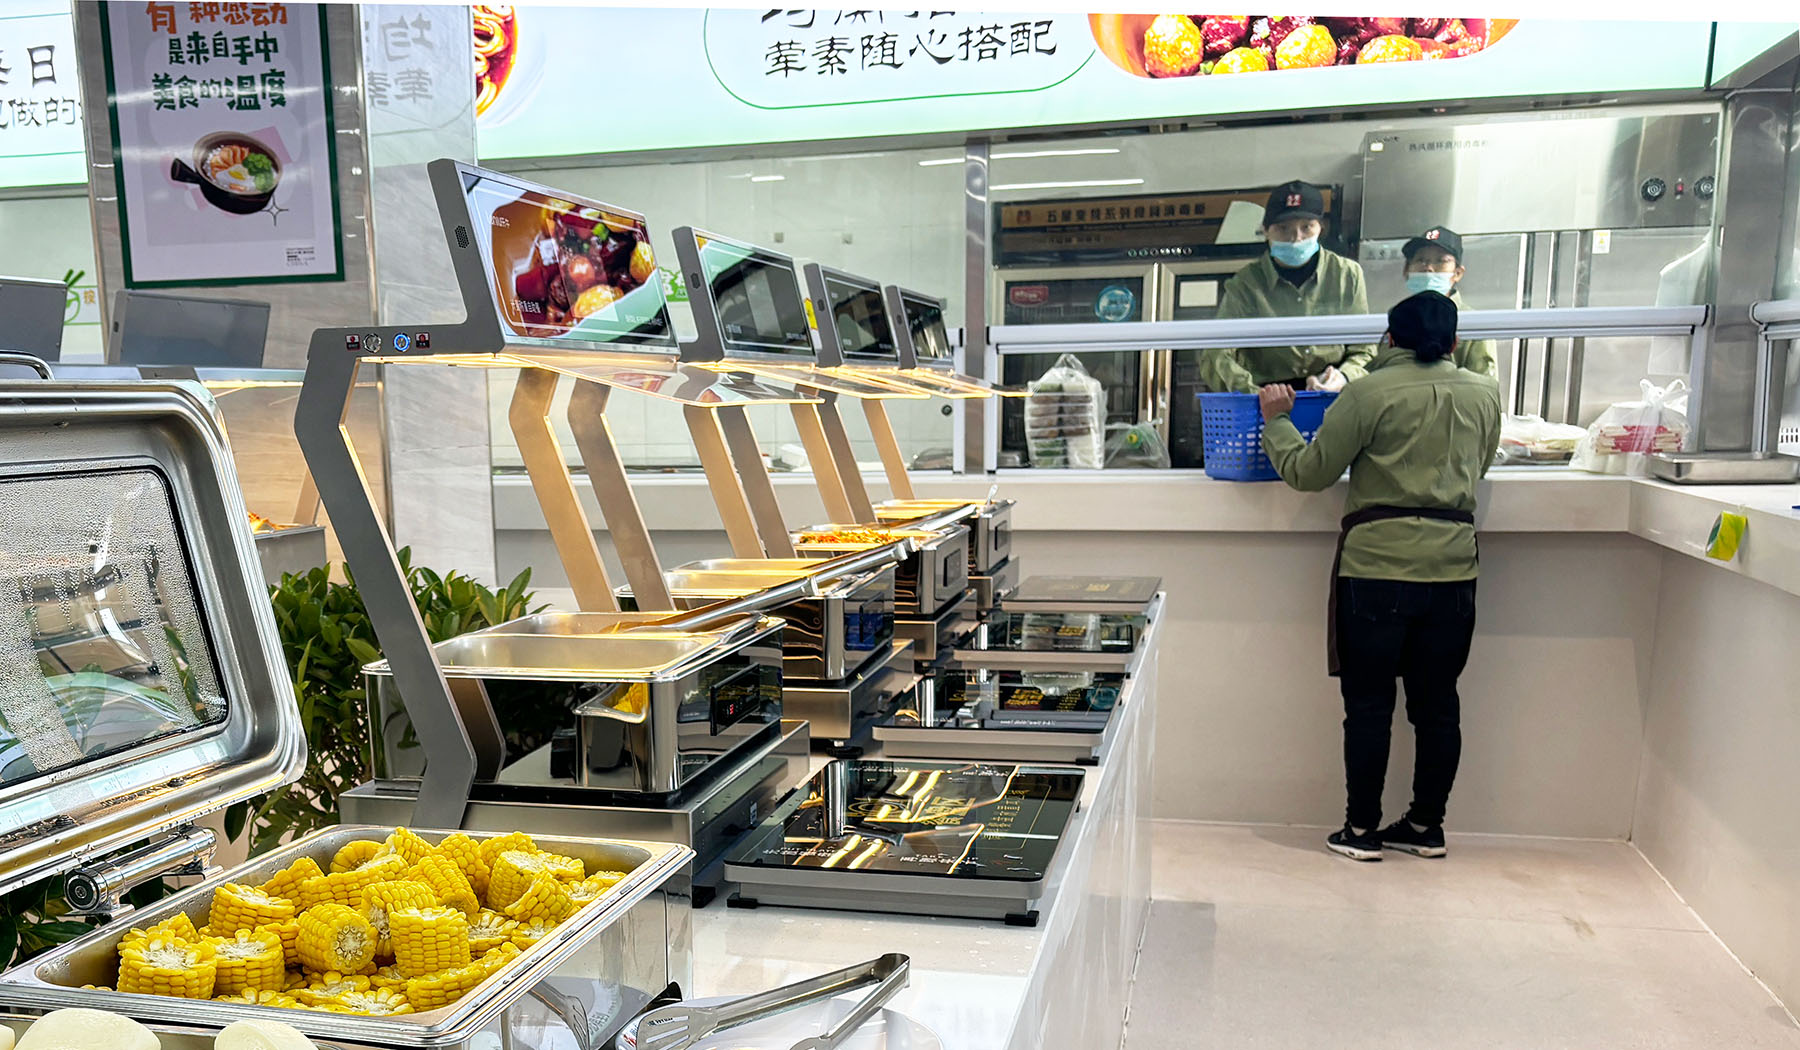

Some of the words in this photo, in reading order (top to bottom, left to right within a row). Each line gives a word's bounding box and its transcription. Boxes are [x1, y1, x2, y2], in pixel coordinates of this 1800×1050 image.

[169, 31, 279, 65] 是来自手中
[764, 20, 1057, 78] 荤素随心搭配
[152, 69, 287, 111] 美食的温度
[0, 96, 82, 129] 做的
